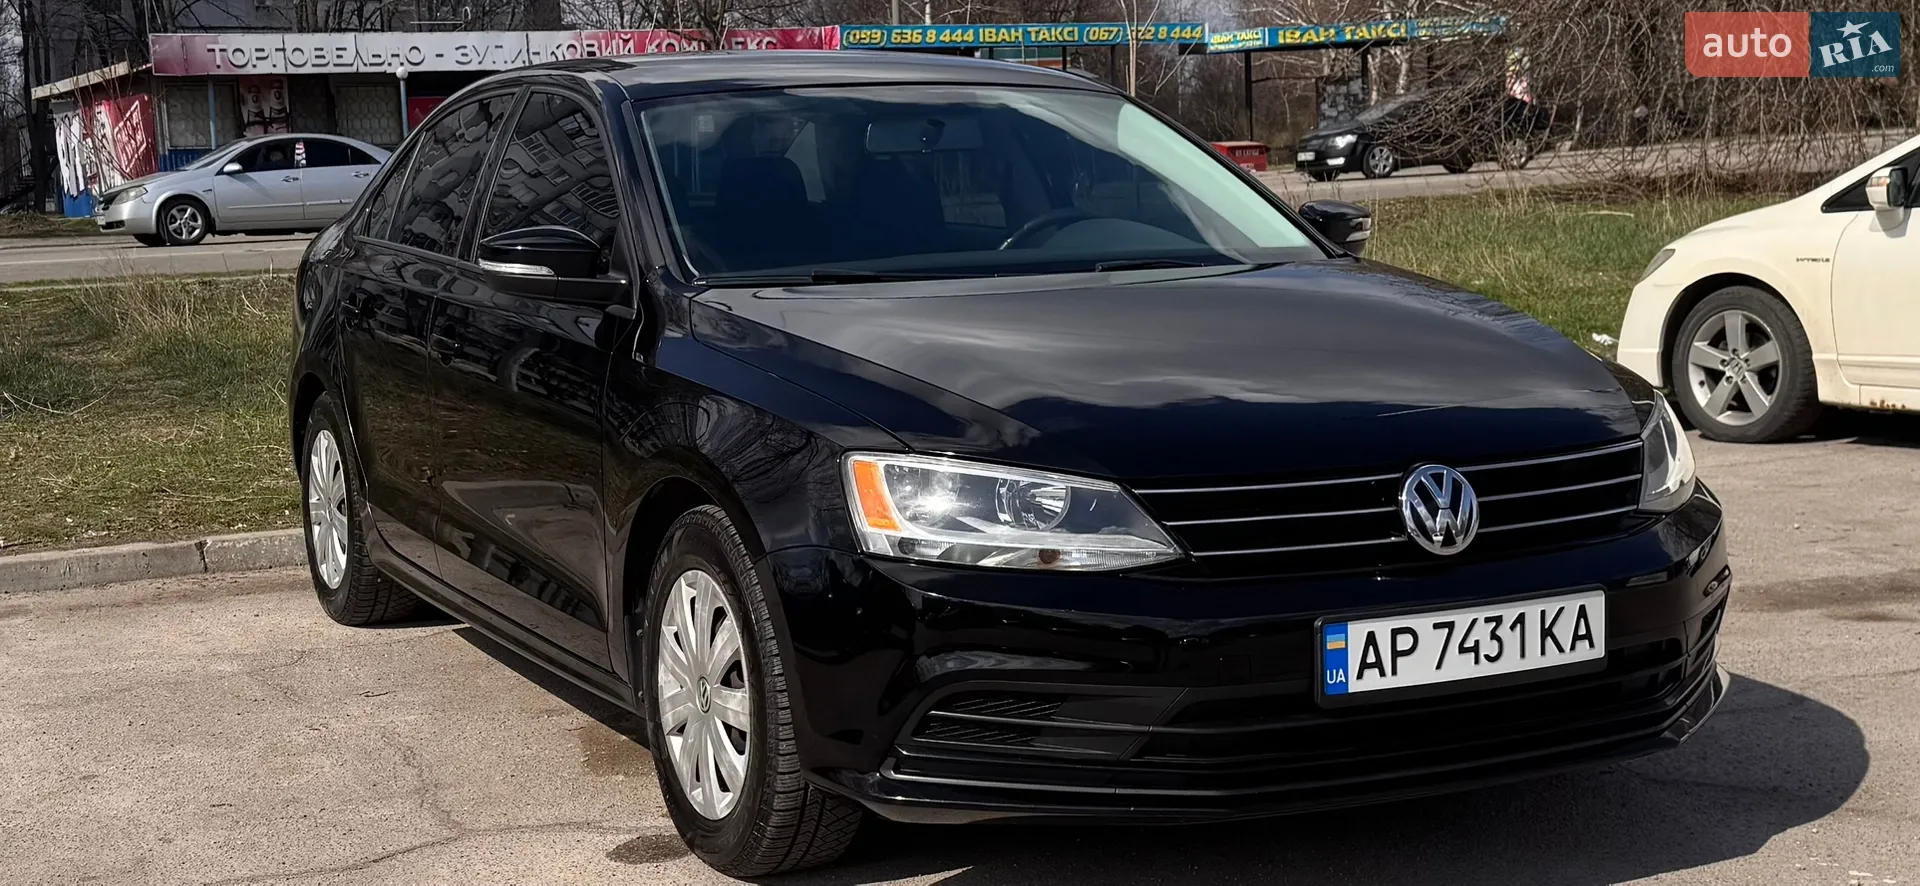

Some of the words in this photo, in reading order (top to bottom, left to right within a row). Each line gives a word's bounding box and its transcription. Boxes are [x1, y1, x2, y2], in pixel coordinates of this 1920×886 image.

[926, 29, 936, 43] 8
[940, 28, 974, 43] 444
[1028, 26, 1079, 42] ТАКСІ
[1083, 26, 1123, 44] (067)
[1157, 26, 1167, 39] 8
[1170, 25, 1203, 39] 444
[206, 44, 426, 68] ТОРГОВЕЛЬНО
[645, 37, 778, 53] КОМЕКС
[1432, 611, 1526, 671] 7431
[1326, 668, 1346, 685] UA
